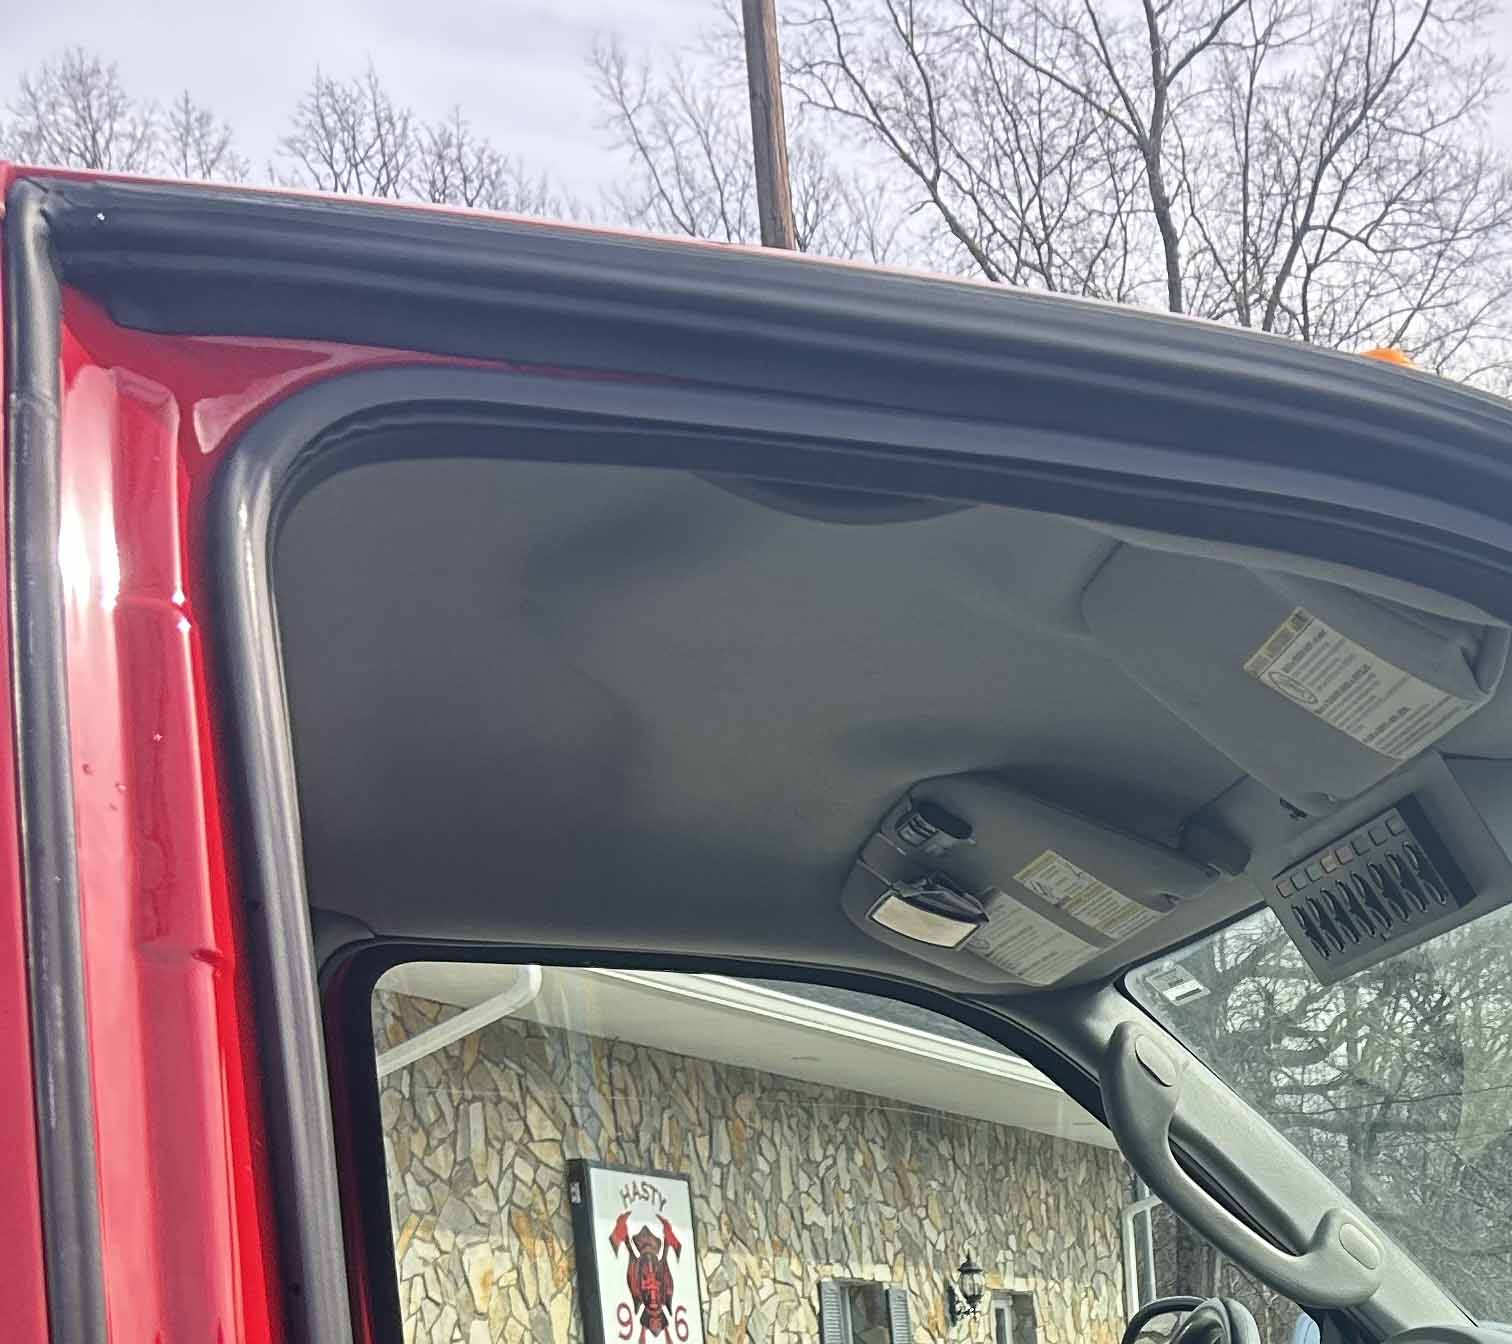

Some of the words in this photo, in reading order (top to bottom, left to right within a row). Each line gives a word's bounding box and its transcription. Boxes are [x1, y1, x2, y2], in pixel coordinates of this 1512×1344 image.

[619, 1181, 667, 1213] HASTY
[617, 1302, 634, 1341] 9
[674, 1305, 689, 1342] 6
